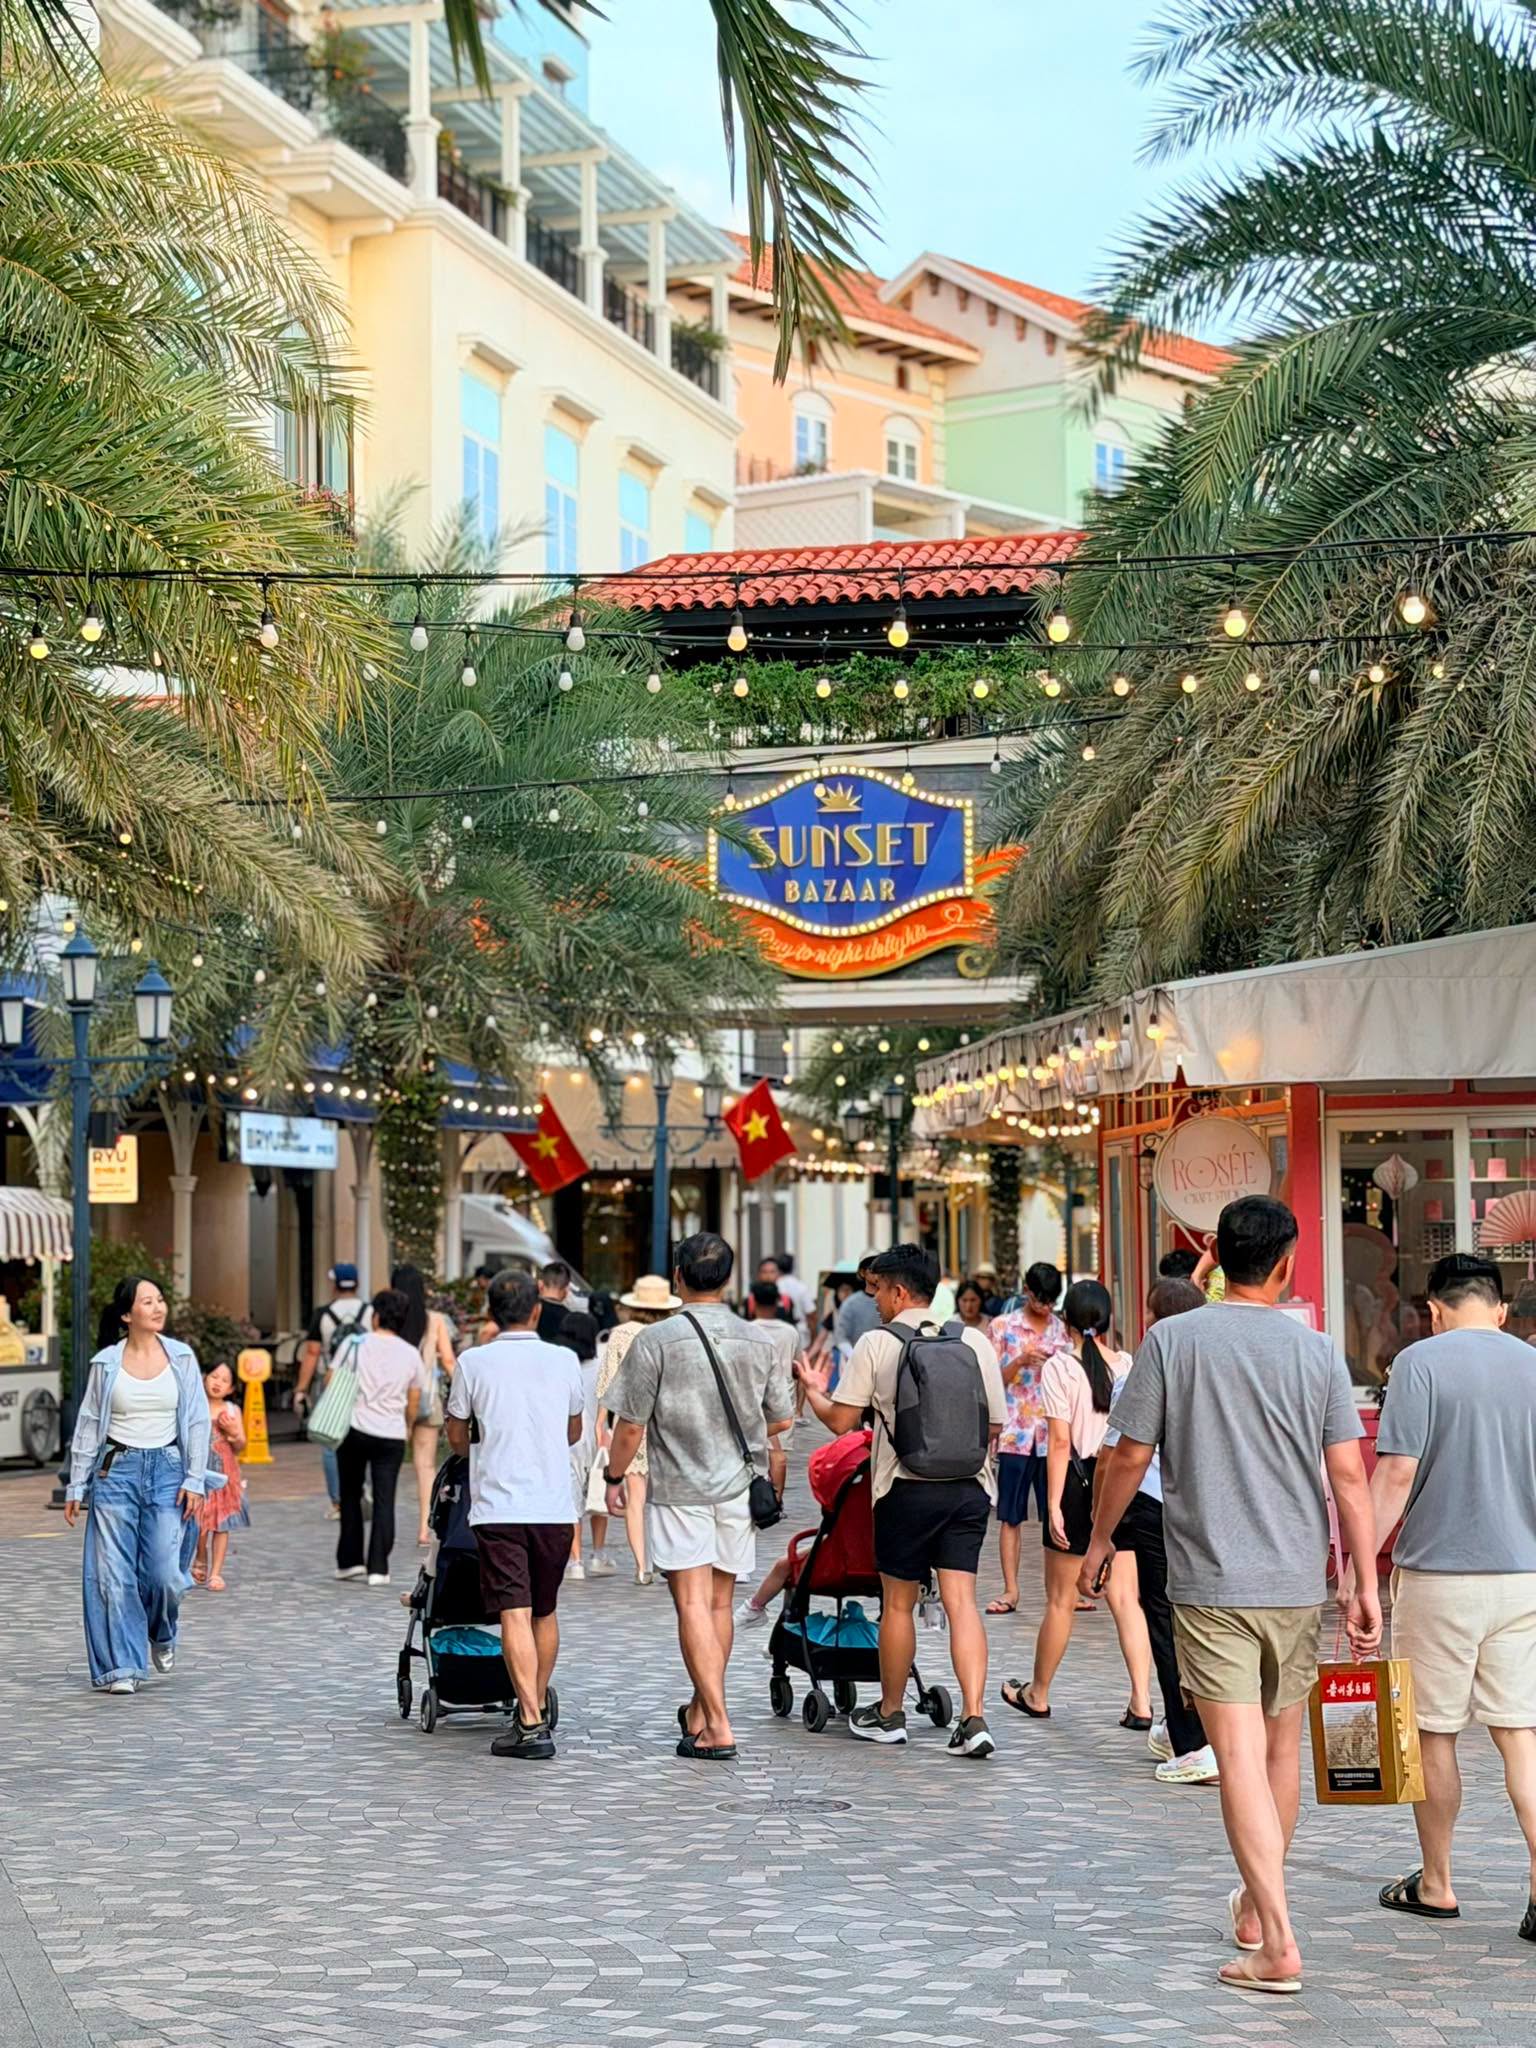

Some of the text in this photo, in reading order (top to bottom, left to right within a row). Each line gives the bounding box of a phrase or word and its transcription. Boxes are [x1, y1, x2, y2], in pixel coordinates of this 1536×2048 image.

[749, 822, 935, 869] SUNSET
[784, 878, 896, 904] BAZAAR
[795, 942, 815, 961] to
[816, 942, 864, 972] night
[93, 1150, 128, 1163] RYU
[1172, 1144, 1257, 1190] ROSÉE
